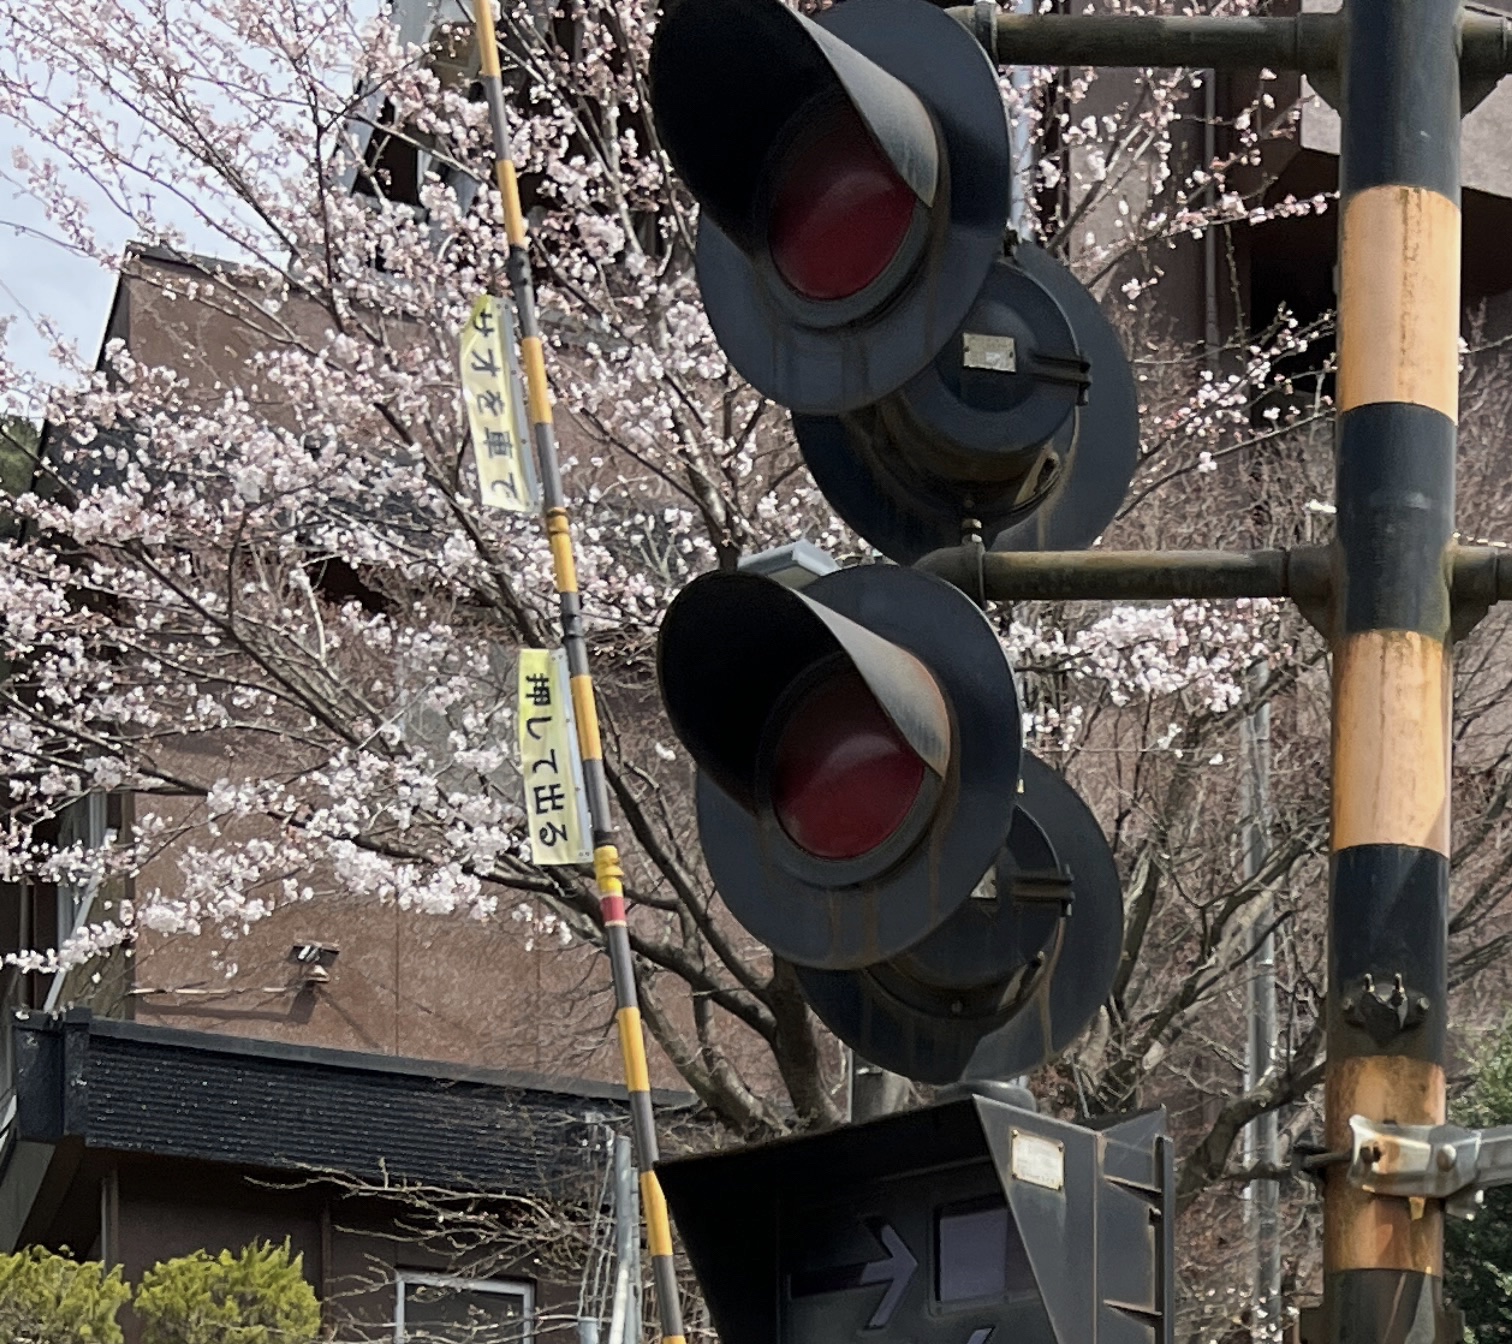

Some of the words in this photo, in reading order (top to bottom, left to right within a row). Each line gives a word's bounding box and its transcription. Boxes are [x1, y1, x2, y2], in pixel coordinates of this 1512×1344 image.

[471, 307, 519, 500] サオを車で
[525, 672, 570, 848] 押して出る
